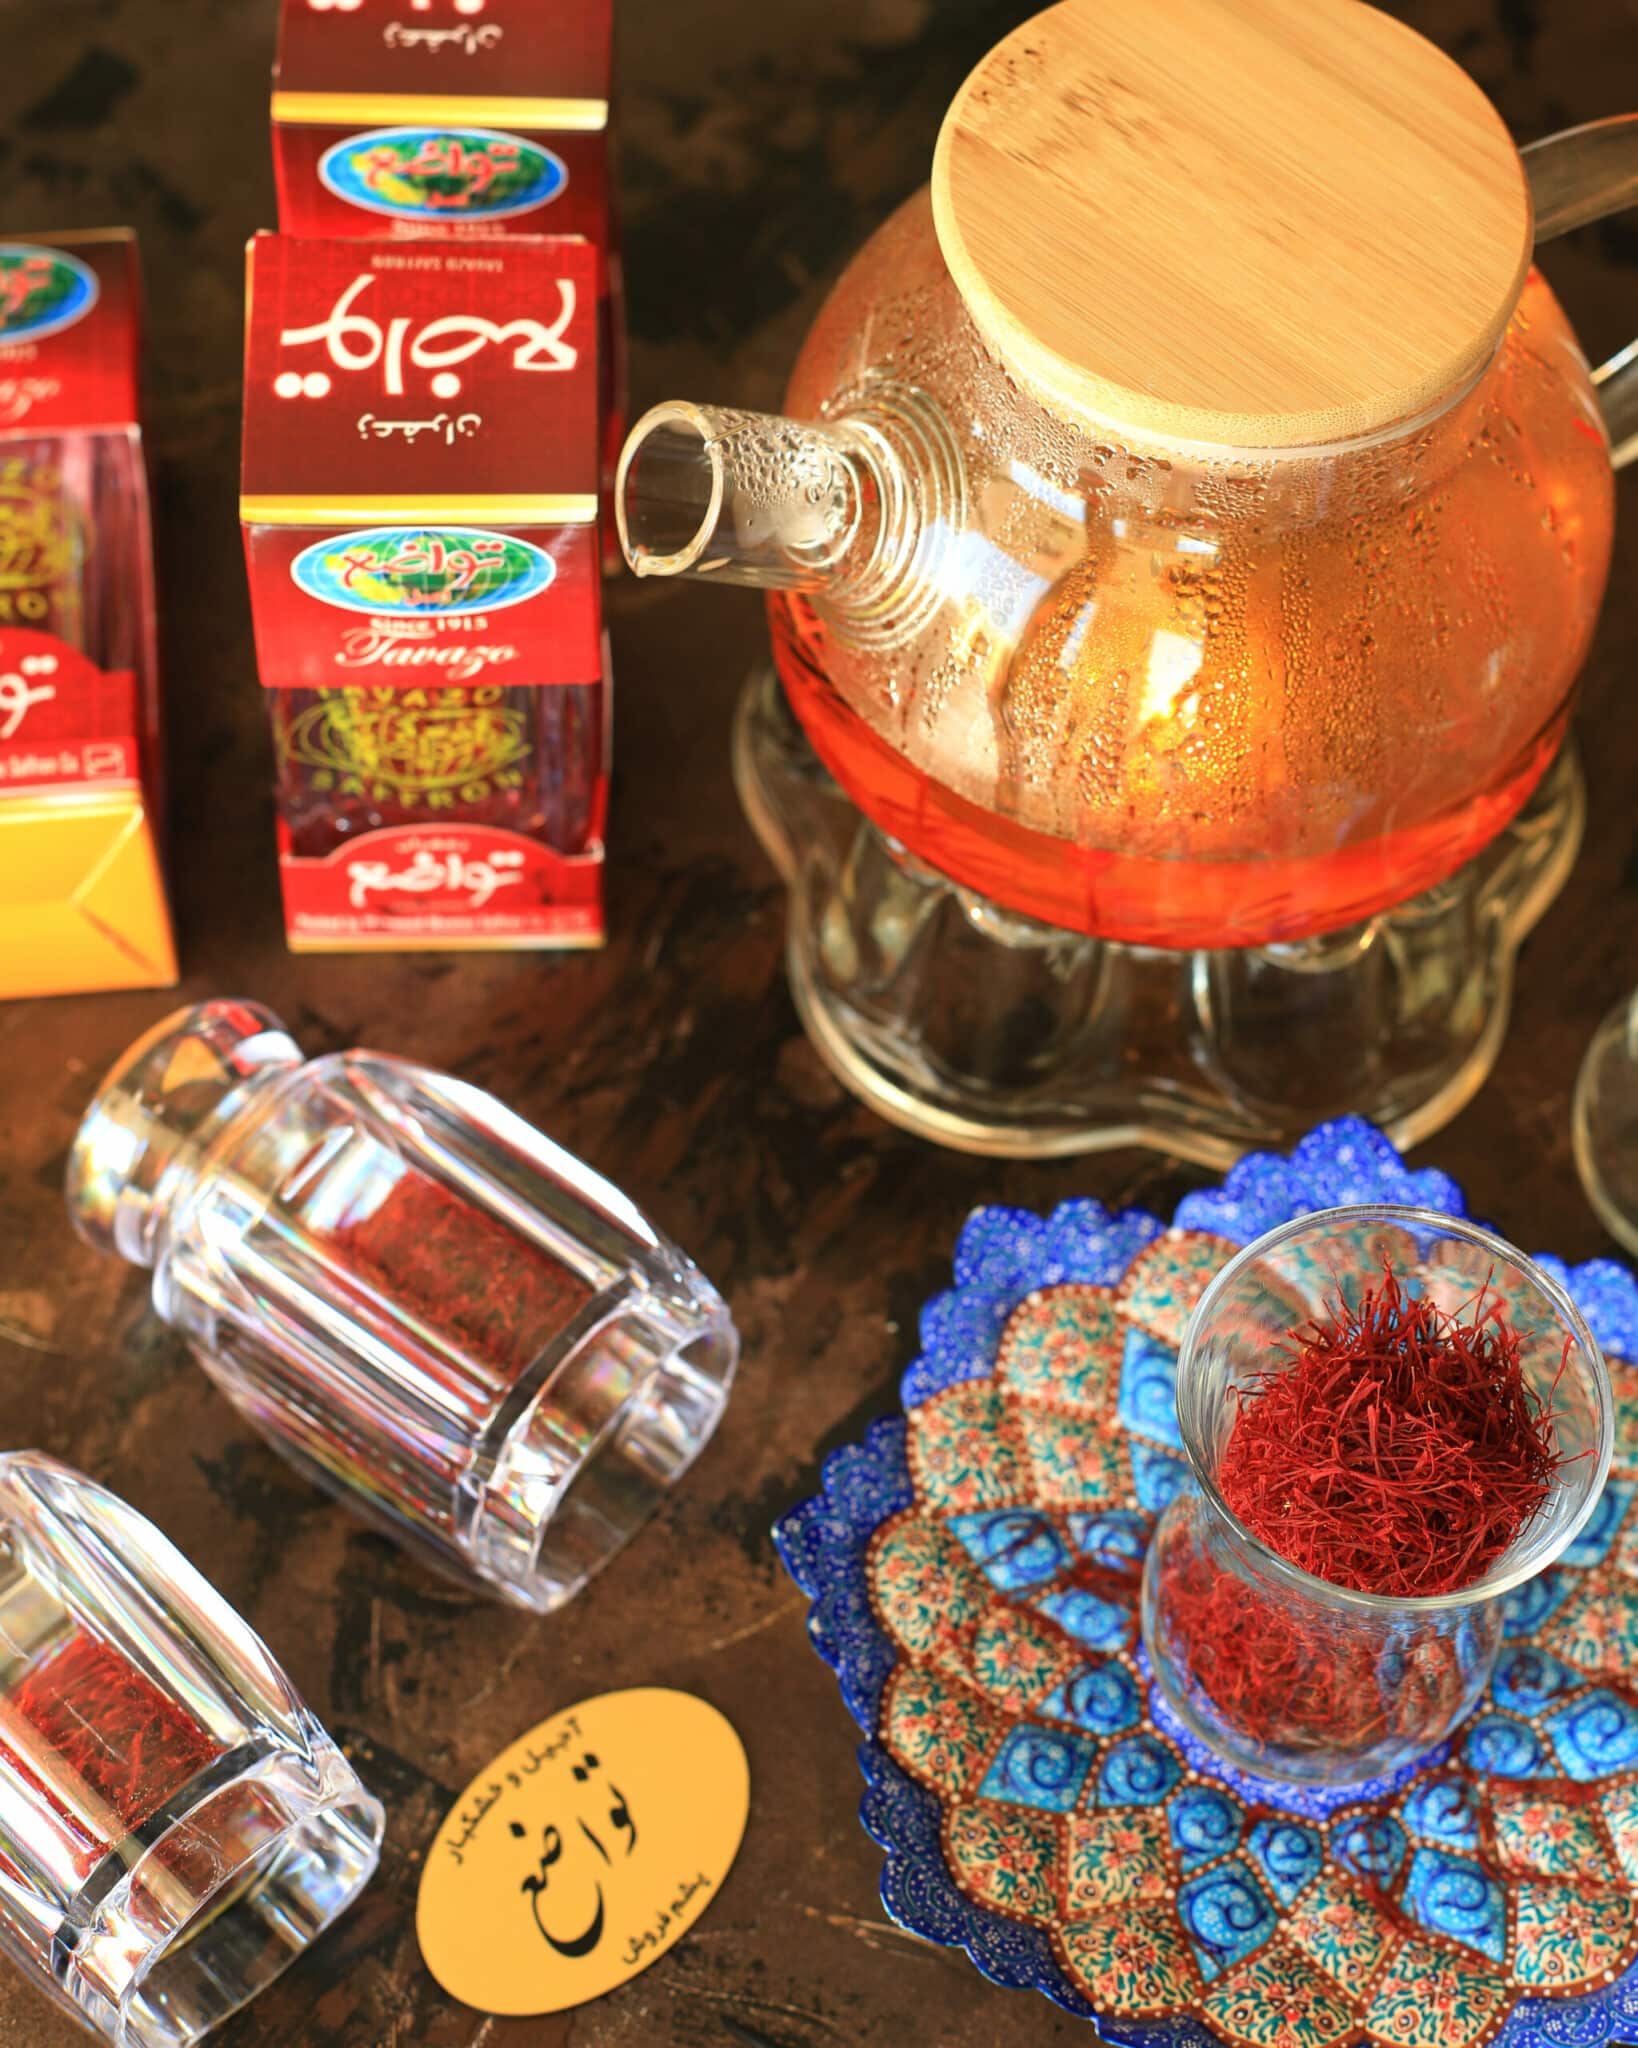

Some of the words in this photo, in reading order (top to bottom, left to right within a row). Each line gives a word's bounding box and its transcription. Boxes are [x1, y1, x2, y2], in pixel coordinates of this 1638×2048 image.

[383, 22, 503, 54] زعفران
[273, 273, 578, 399] تواضع
[357, 413, 482, 446] زعفران
[341, 540, 504, 589] تواضع
[334, 628, 518, 679] Tavazo
[347, 851, 525, 908] تواضع
[509, 1752, 638, 1959] تواضع
